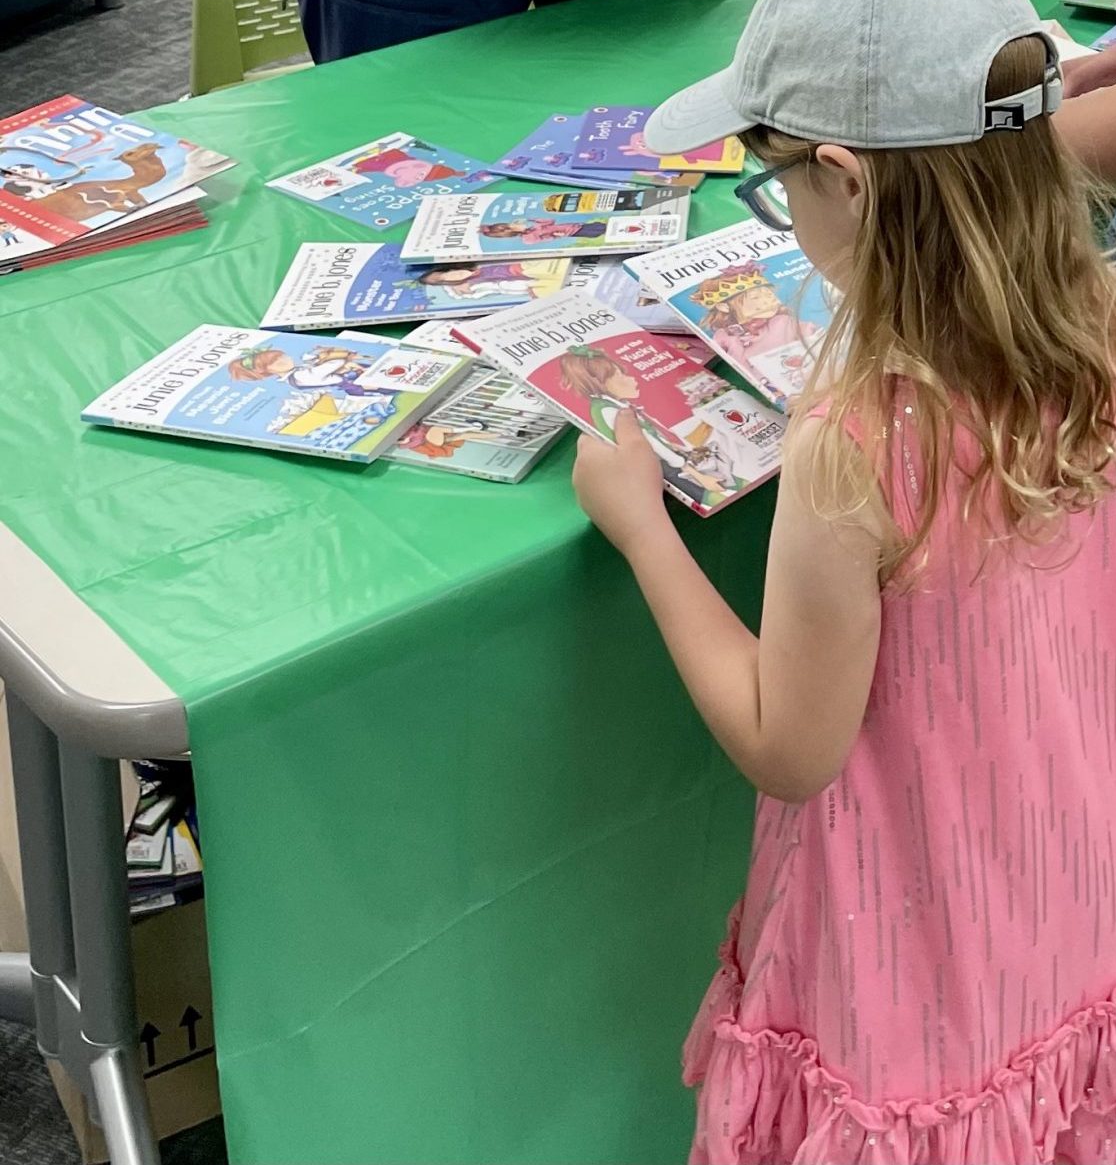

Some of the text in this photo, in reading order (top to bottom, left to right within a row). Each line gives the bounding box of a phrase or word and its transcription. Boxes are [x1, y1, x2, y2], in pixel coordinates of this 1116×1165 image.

[589, 120, 613, 141] Tooth
[452, 196, 480, 218] jones
[657, 254, 719, 288] junie
[716, 248, 746, 262] b.
[305, 247, 357, 317] junie b. jones
[500, 309, 617, 366] junie b. jones
[620, 344, 659, 363] Yucky
[633, 351, 675, 371] Blucky
[132, 378, 184, 415] junie
[168, 363, 204, 378] b.
[201, 332, 250, 368] jones
[641, 358, 687, 382] Fruitcake
